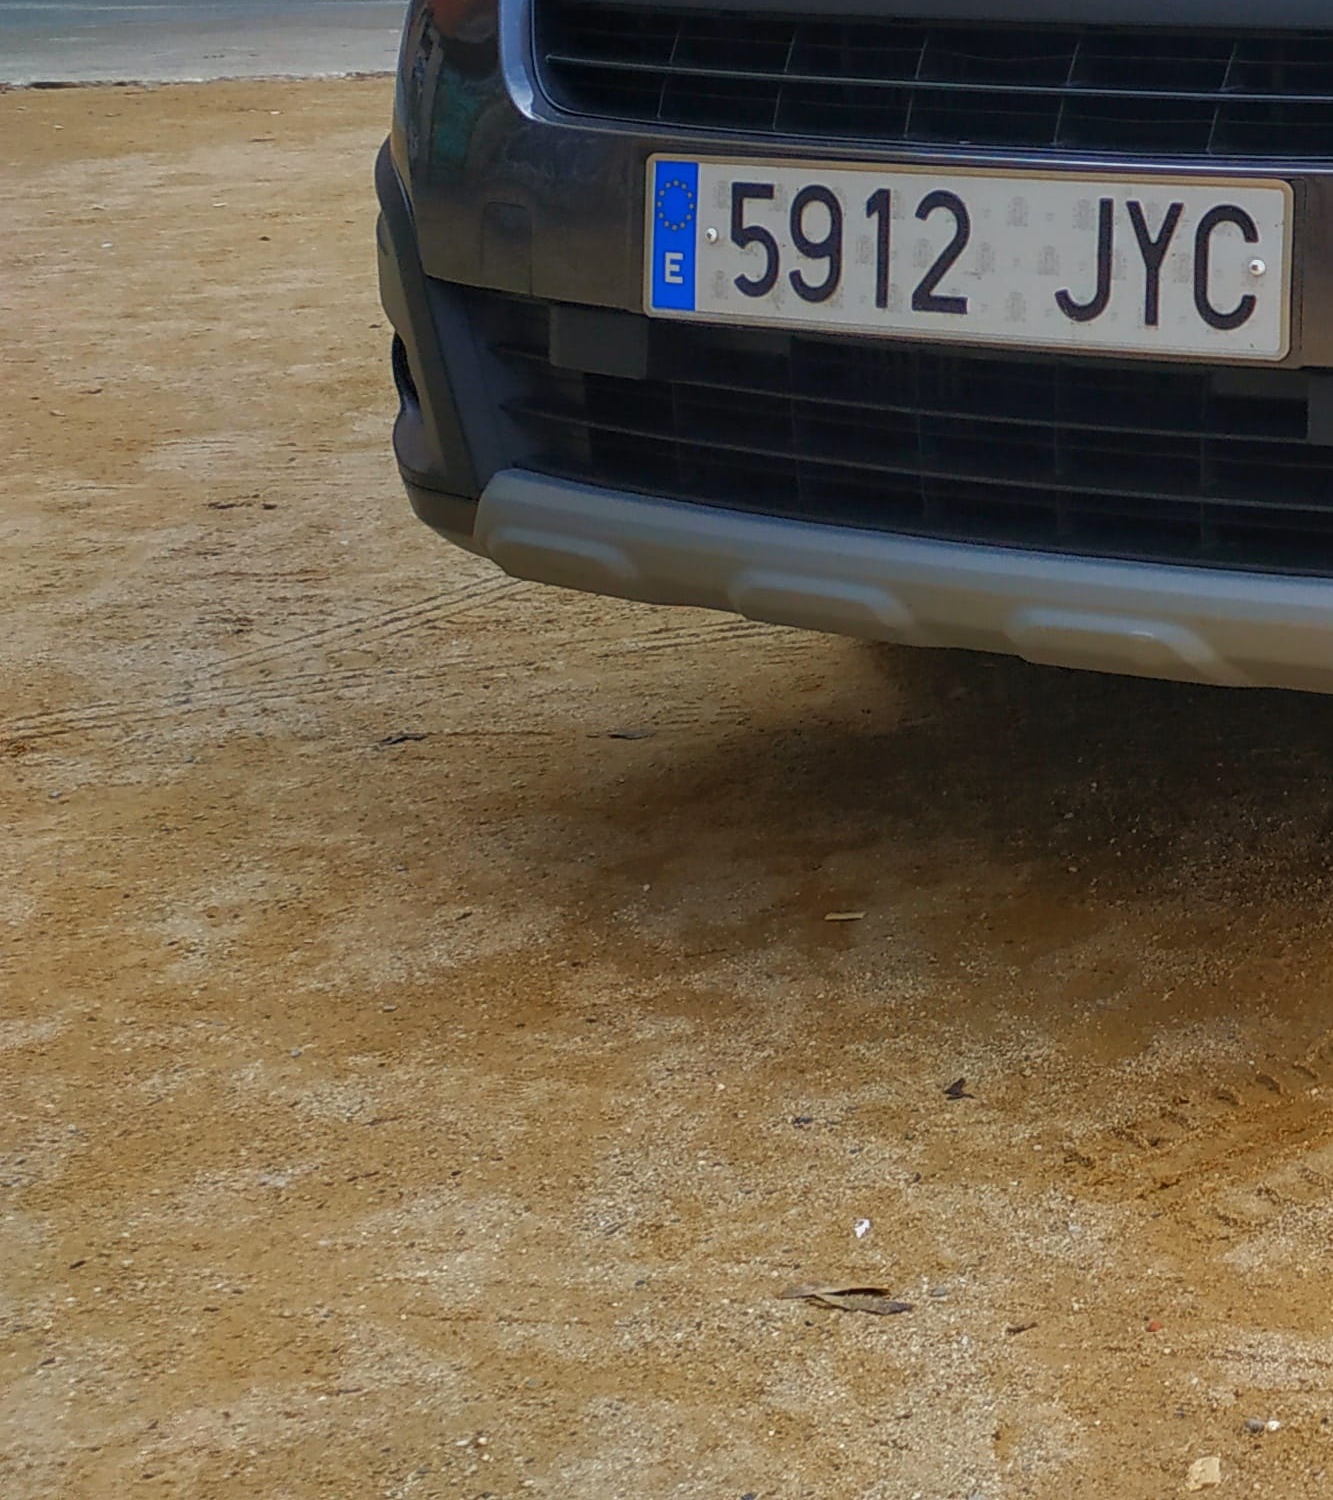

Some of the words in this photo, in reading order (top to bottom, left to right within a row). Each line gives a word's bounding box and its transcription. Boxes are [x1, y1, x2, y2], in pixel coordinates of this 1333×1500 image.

[664, 252, 684, 285] E
[730, 182, 971, 315] 5912
[1054, 197, 1260, 331] JYC
